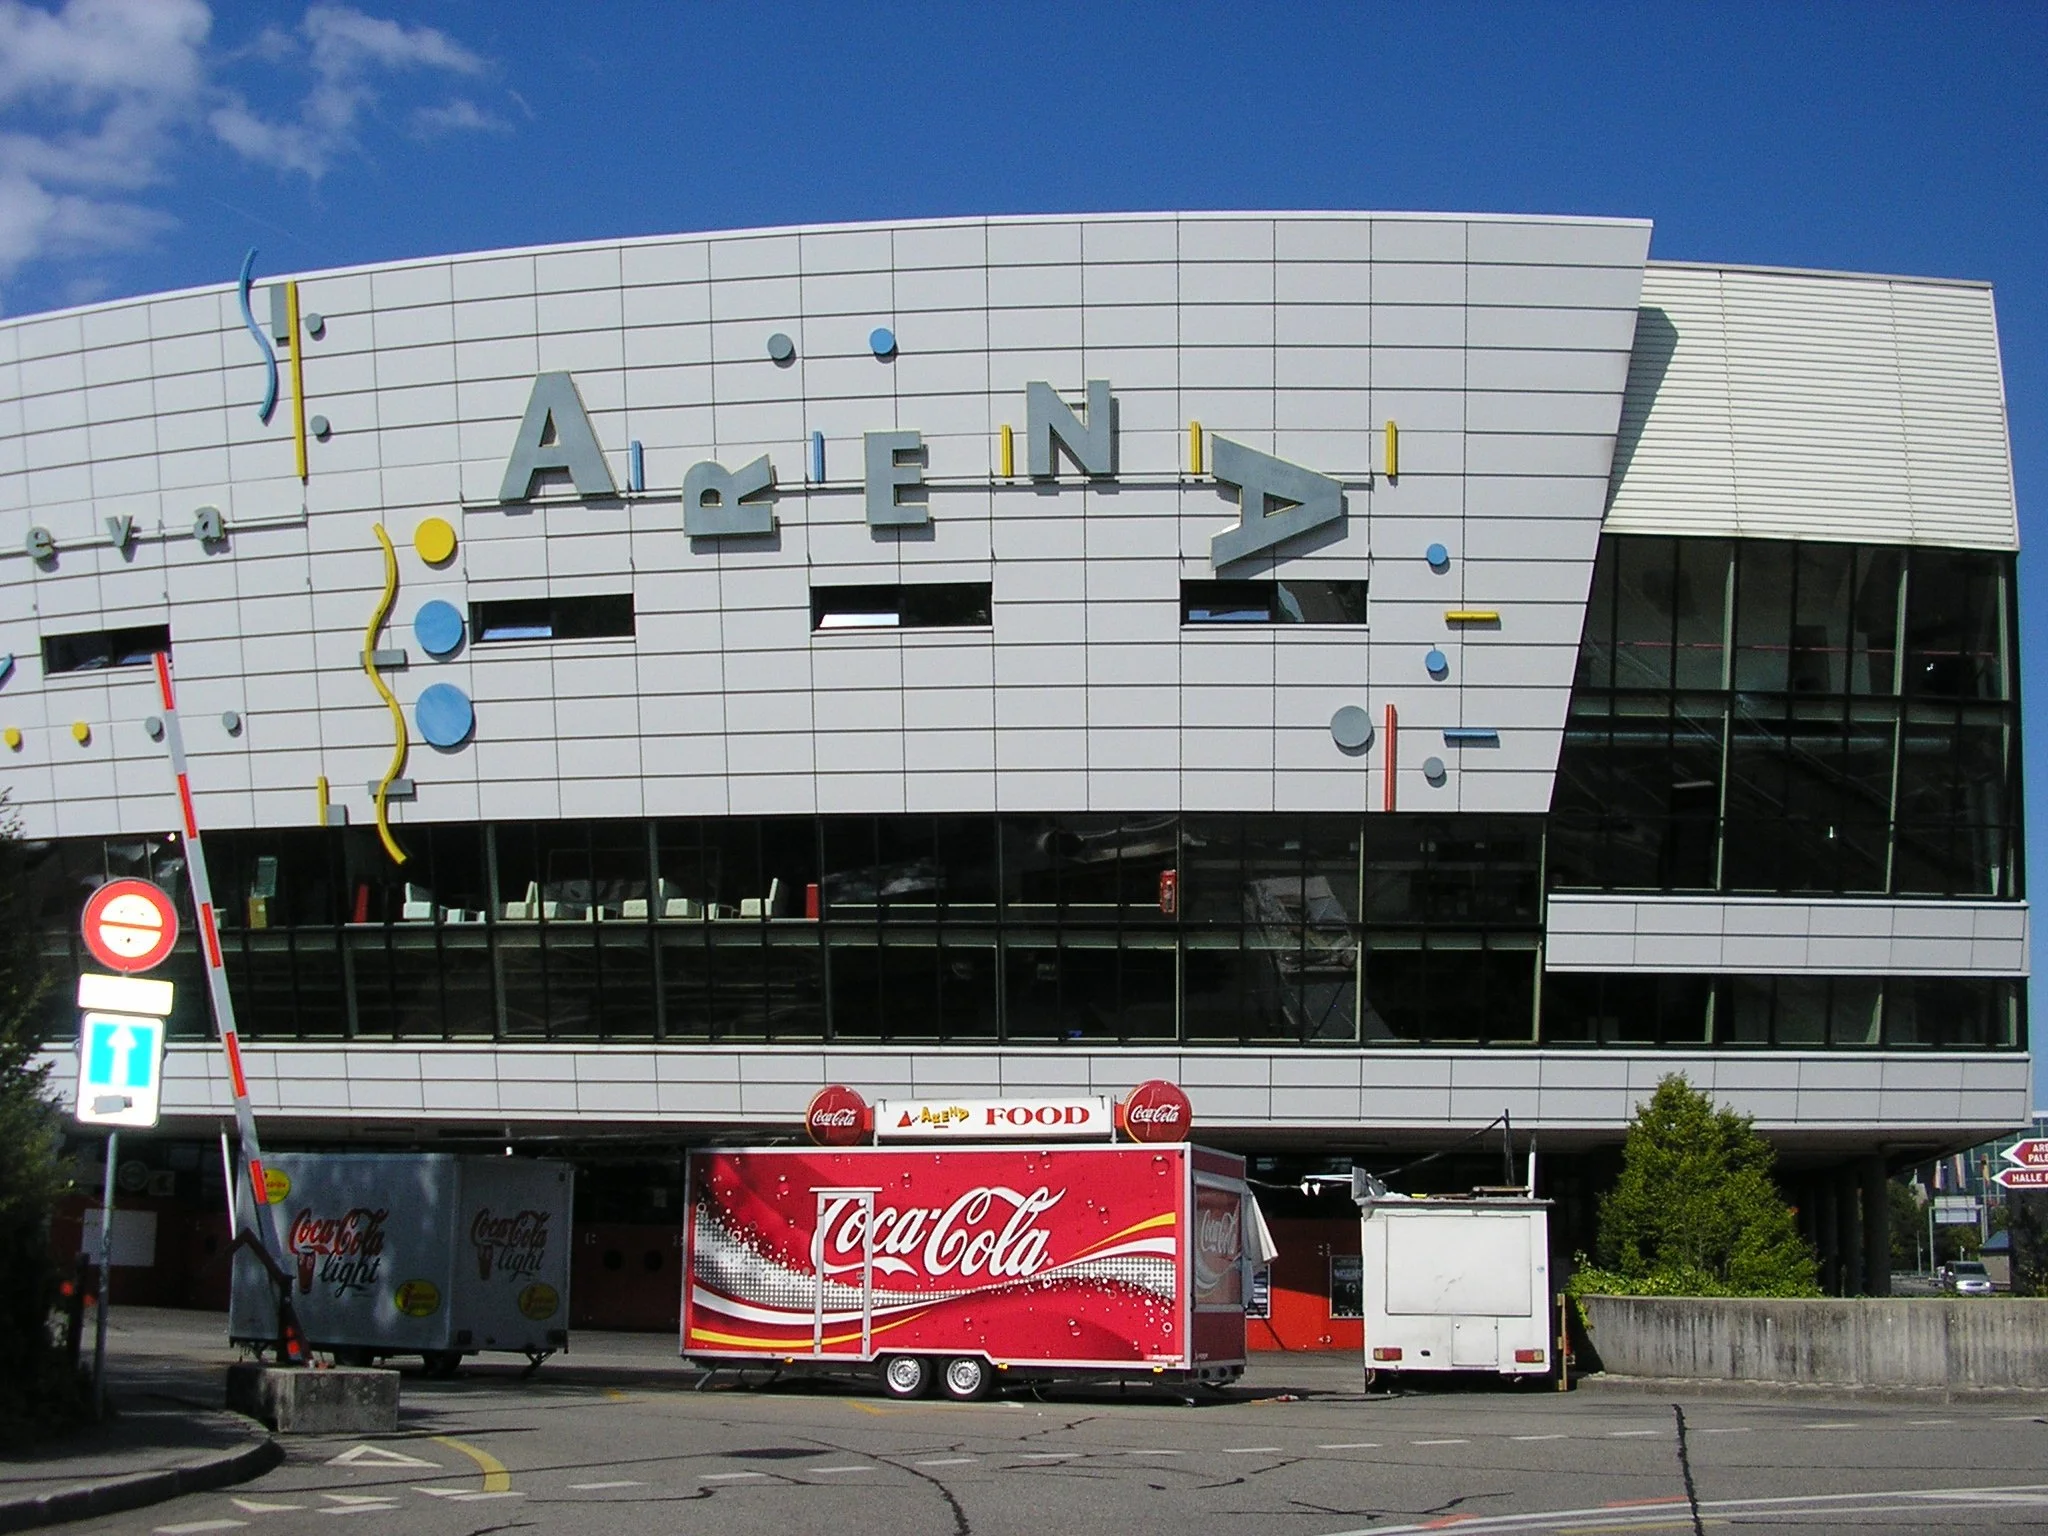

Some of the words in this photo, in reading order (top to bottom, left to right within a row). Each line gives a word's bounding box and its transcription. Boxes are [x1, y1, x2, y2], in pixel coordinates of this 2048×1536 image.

[498, 370, 1345, 570] ARENA
[985, 1106, 1090, 1125] FOOD
[2011, 1173, 2043, 1182] HALLE
[810, 1186, 1066, 1276] Coca-Cola
[318, 1251, 381, 1298] light
[497, 1245, 546, 1283] light
